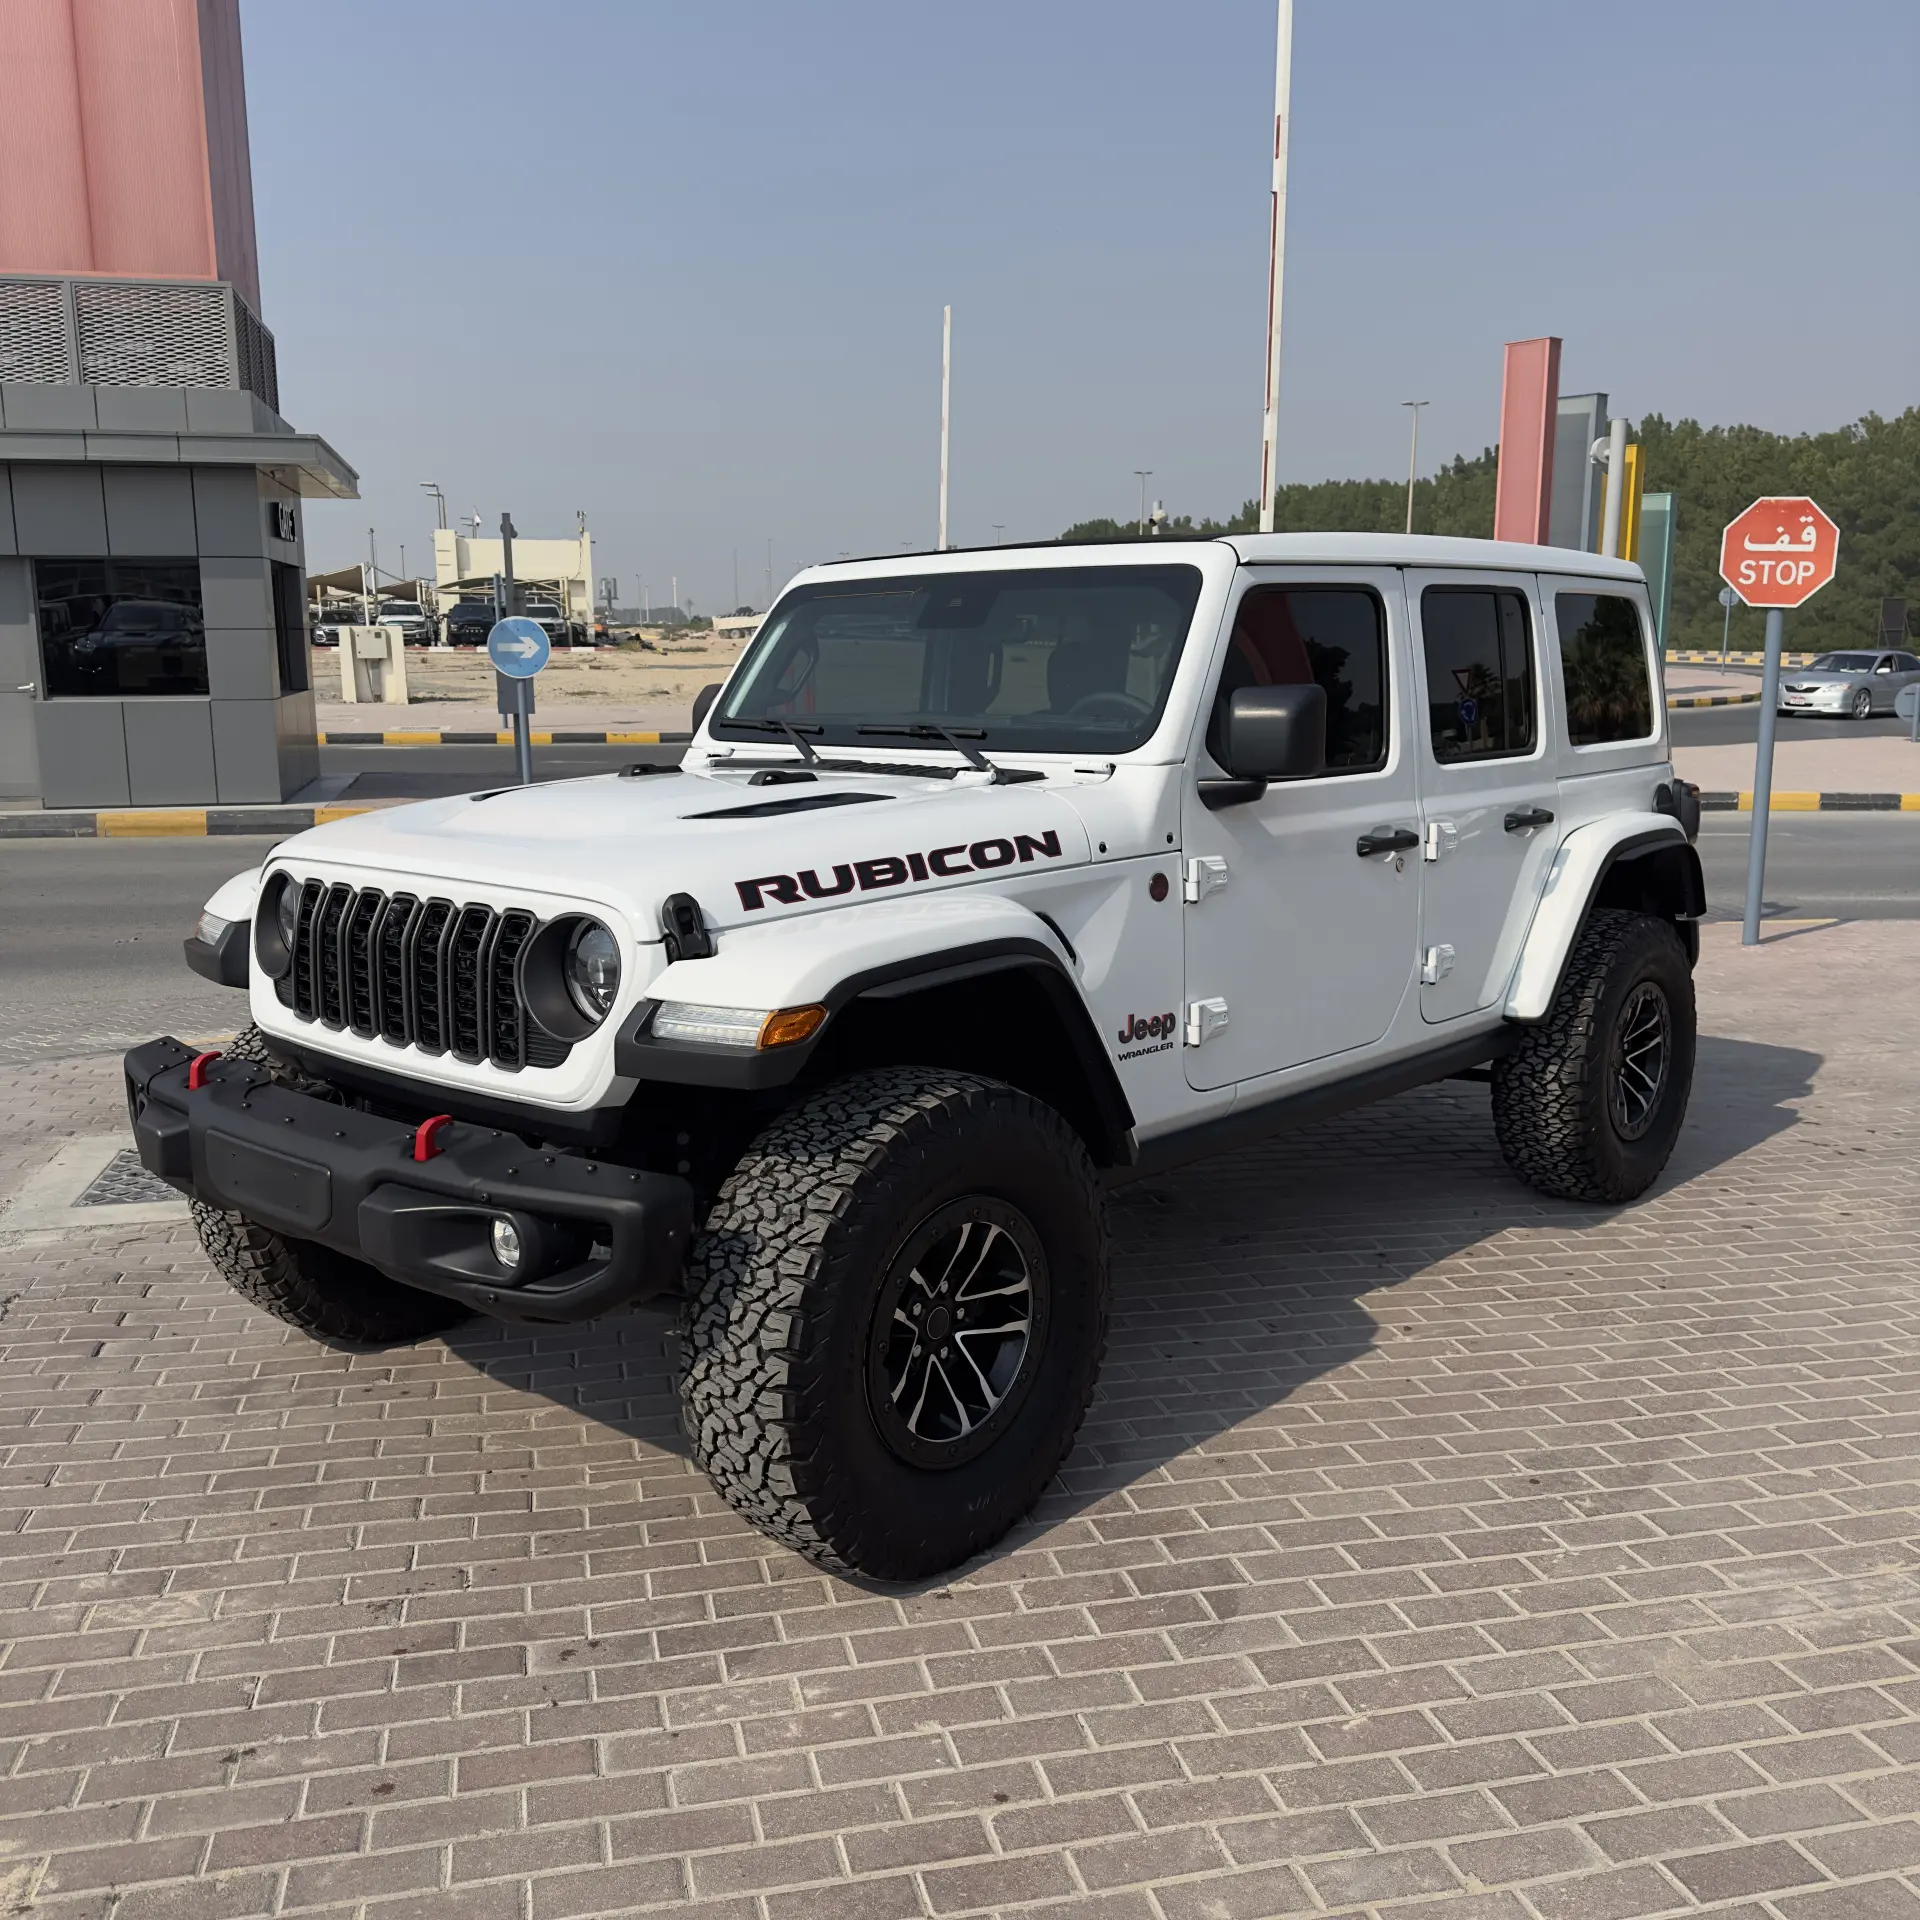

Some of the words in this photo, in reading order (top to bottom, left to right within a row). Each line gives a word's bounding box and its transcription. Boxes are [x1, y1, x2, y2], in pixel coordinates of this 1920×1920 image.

[1744, 516, 1816, 552] قف
[1738, 560, 1815, 585] STOP
[735, 830, 1062, 911] RUBICON
[1118, 1012, 1176, 1044] Jeep
[1118, 1042, 1174, 1061] WRANGLER
